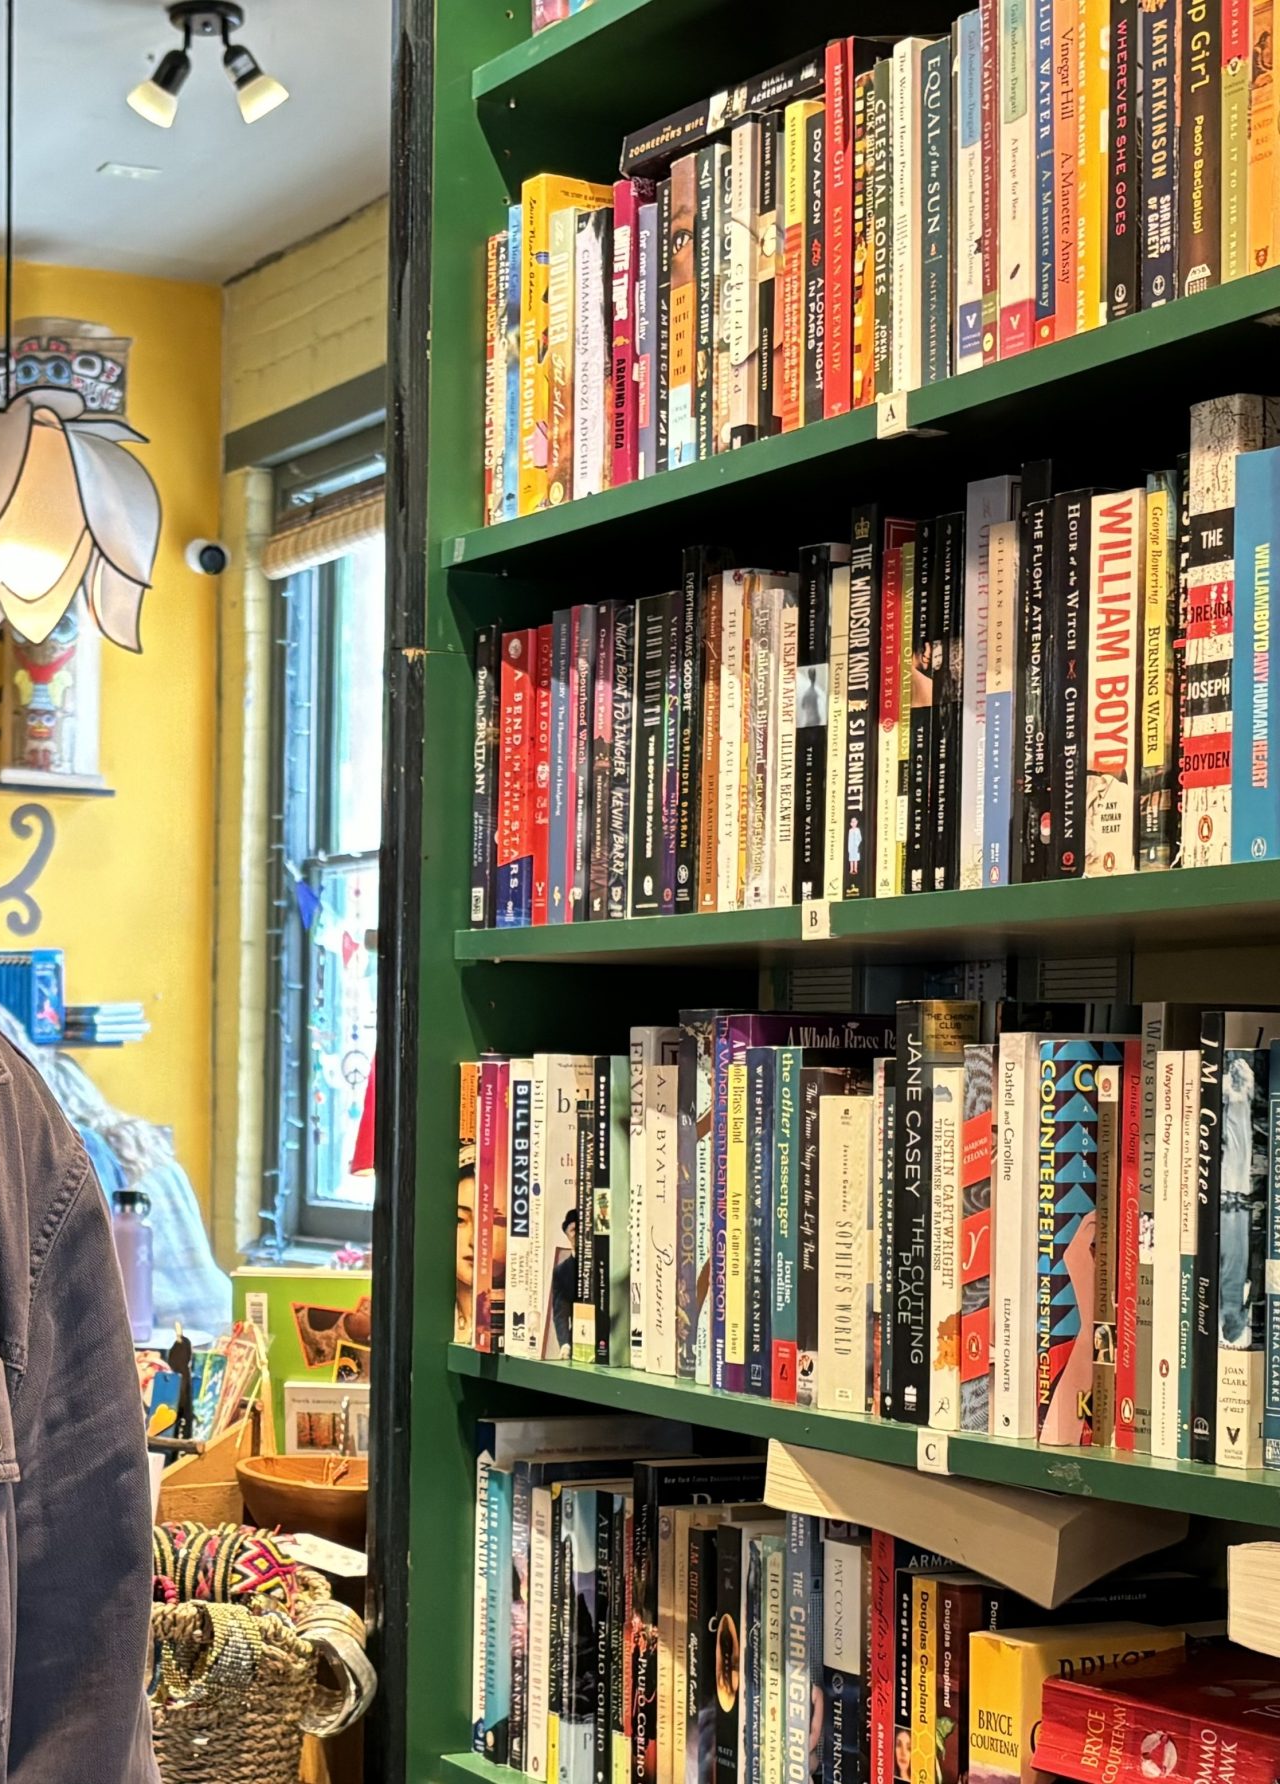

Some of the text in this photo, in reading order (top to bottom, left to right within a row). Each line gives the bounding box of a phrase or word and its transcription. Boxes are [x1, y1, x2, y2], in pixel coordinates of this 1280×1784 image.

[628, 116, 705, 158] ZOOKEEPER'S WIFE
[749, 79, 794, 105] ACKERMAN
[924, 55, 941, 235] EQUAL of the SUN
[1115, 19, 1127, 236] WHEREVER SHE GOES
[1151, 19, 1168, 180] KATE ATKINSON
[1190, 31, 1210, 234] Girl Paolo Bacigalupi
[812, 128, 822, 225] DOV ALFON
[875, 99, 887, 296] CELESTIAL BODIES
[1057, 27, 1074, 284] Vinegar Hill A. Manette Ansay
[700, 195, 711, 345] The MAGDALEN GIRLS
[1147, 196, 1159, 259] OF GAIETY
[1159, 195, 1171, 254] SHRINES
[580, 250, 590, 479] CHIMAMANDA NGOZI ADICHIE
[807, 281, 817, 350] IN PARIS
[815, 278, 824, 390] A LONG NIGHT
[659, 299, 669, 447] AMERICAN WAR
[886, 403, 896, 422] A
[1067, 503, 1081, 554] HOUR
[1199, 528, 1224, 550] THE
[884, 559, 897, 709] ELIZABETH BERG
[1031, 509, 1043, 697] THE FLIGHT ATTENDANT
[1067, 590, 1080, 651] WITCH
[1092, 498, 1133, 773] WILLIAM BOYD
[1146, 506, 1163, 755] George Bowering BURNING WATER
[578, 638, 588, 765] Neighbourhood Watch
[779, 621, 796, 842] AN ISLAND APART LILLIAN BECKWITH
[847, 543, 872, 812] THE WINDSOR KNOT SJ BENNETT
[1065, 687, 1079, 740] CHRIS
[1186, 676, 1231, 701] JOSEPH
[611, 623, 628, 874] NIGHT BOAT TO TANGIER KEVIN BARRY
[1024, 714, 1035, 794] BOHJALIAN
[1034, 731, 1045, 774] CHRIS
[1063, 744, 1079, 839] BOHJALIAN
[1183, 750, 1231, 772] BOYDEN
[810, 910, 818, 927] B
[905, 1033, 922, 1198] JANE CASEY
[1003, 1061, 1016, 1106] Dashell
[1161, 1063, 1175, 1145] Wayson Choy
[480, 1084, 493, 1275] Milkman ANNA BURNS
[514, 1085, 529, 1234] BILL BRYSON
[777, 1053, 794, 1239] the other passenger
[1002, 1128, 1015, 1181] Caroline
[1197, 1035, 1219, 1335] J.M. Coetzee Boyhood
[752, 1065, 764, 1353] WHISPER HOLLOW CHRIS CANDER
[941, 1118, 955, 1290] JUSTIN CARTWRIGHT
[1038, 1060, 1056, 1404] COUNTERFEIT KIRSTIN CHEN
[1122, 1074, 1140, 1368] Denise Chong the Concubine's Children
[776, 1251, 785, 1312] candlish
[784, 1260, 793, 1303] louise
[898, 1252, 911, 1325] PLACE
[910, 1214, 925, 1365] THE CUTTING
[1003, 1297, 1011, 1346] ELIZABETH
[1002, 1348, 1011, 1393] CHANTER
[925, 1442, 937, 1461] C
[596, 1513, 610, 1752] ALEPH PAULO COELHO
[792, 1571, 803, 1598] THE
[833, 1559, 845, 1661] PAT CONROY
[767, 1572, 780, 1761] HOUSE GIRL TARA
[789, 1605, 806, 1720] CHANGE
[899, 1593, 910, 1716] douglas coupland
[918, 1590, 931, 1724] Douglas Coupland
[941, 1599, 953, 1708] Douglas Coupland
[635, 1658, 648, 1777] PAULO COELHO
[970, 1733, 1019, 1760] COURTENAY
[978, 1709, 1013, 1737] BRYCE
[1080, 1709, 1106, 1769] BRYCE
[1100, 1702, 1128, 1784] COURTENAY
